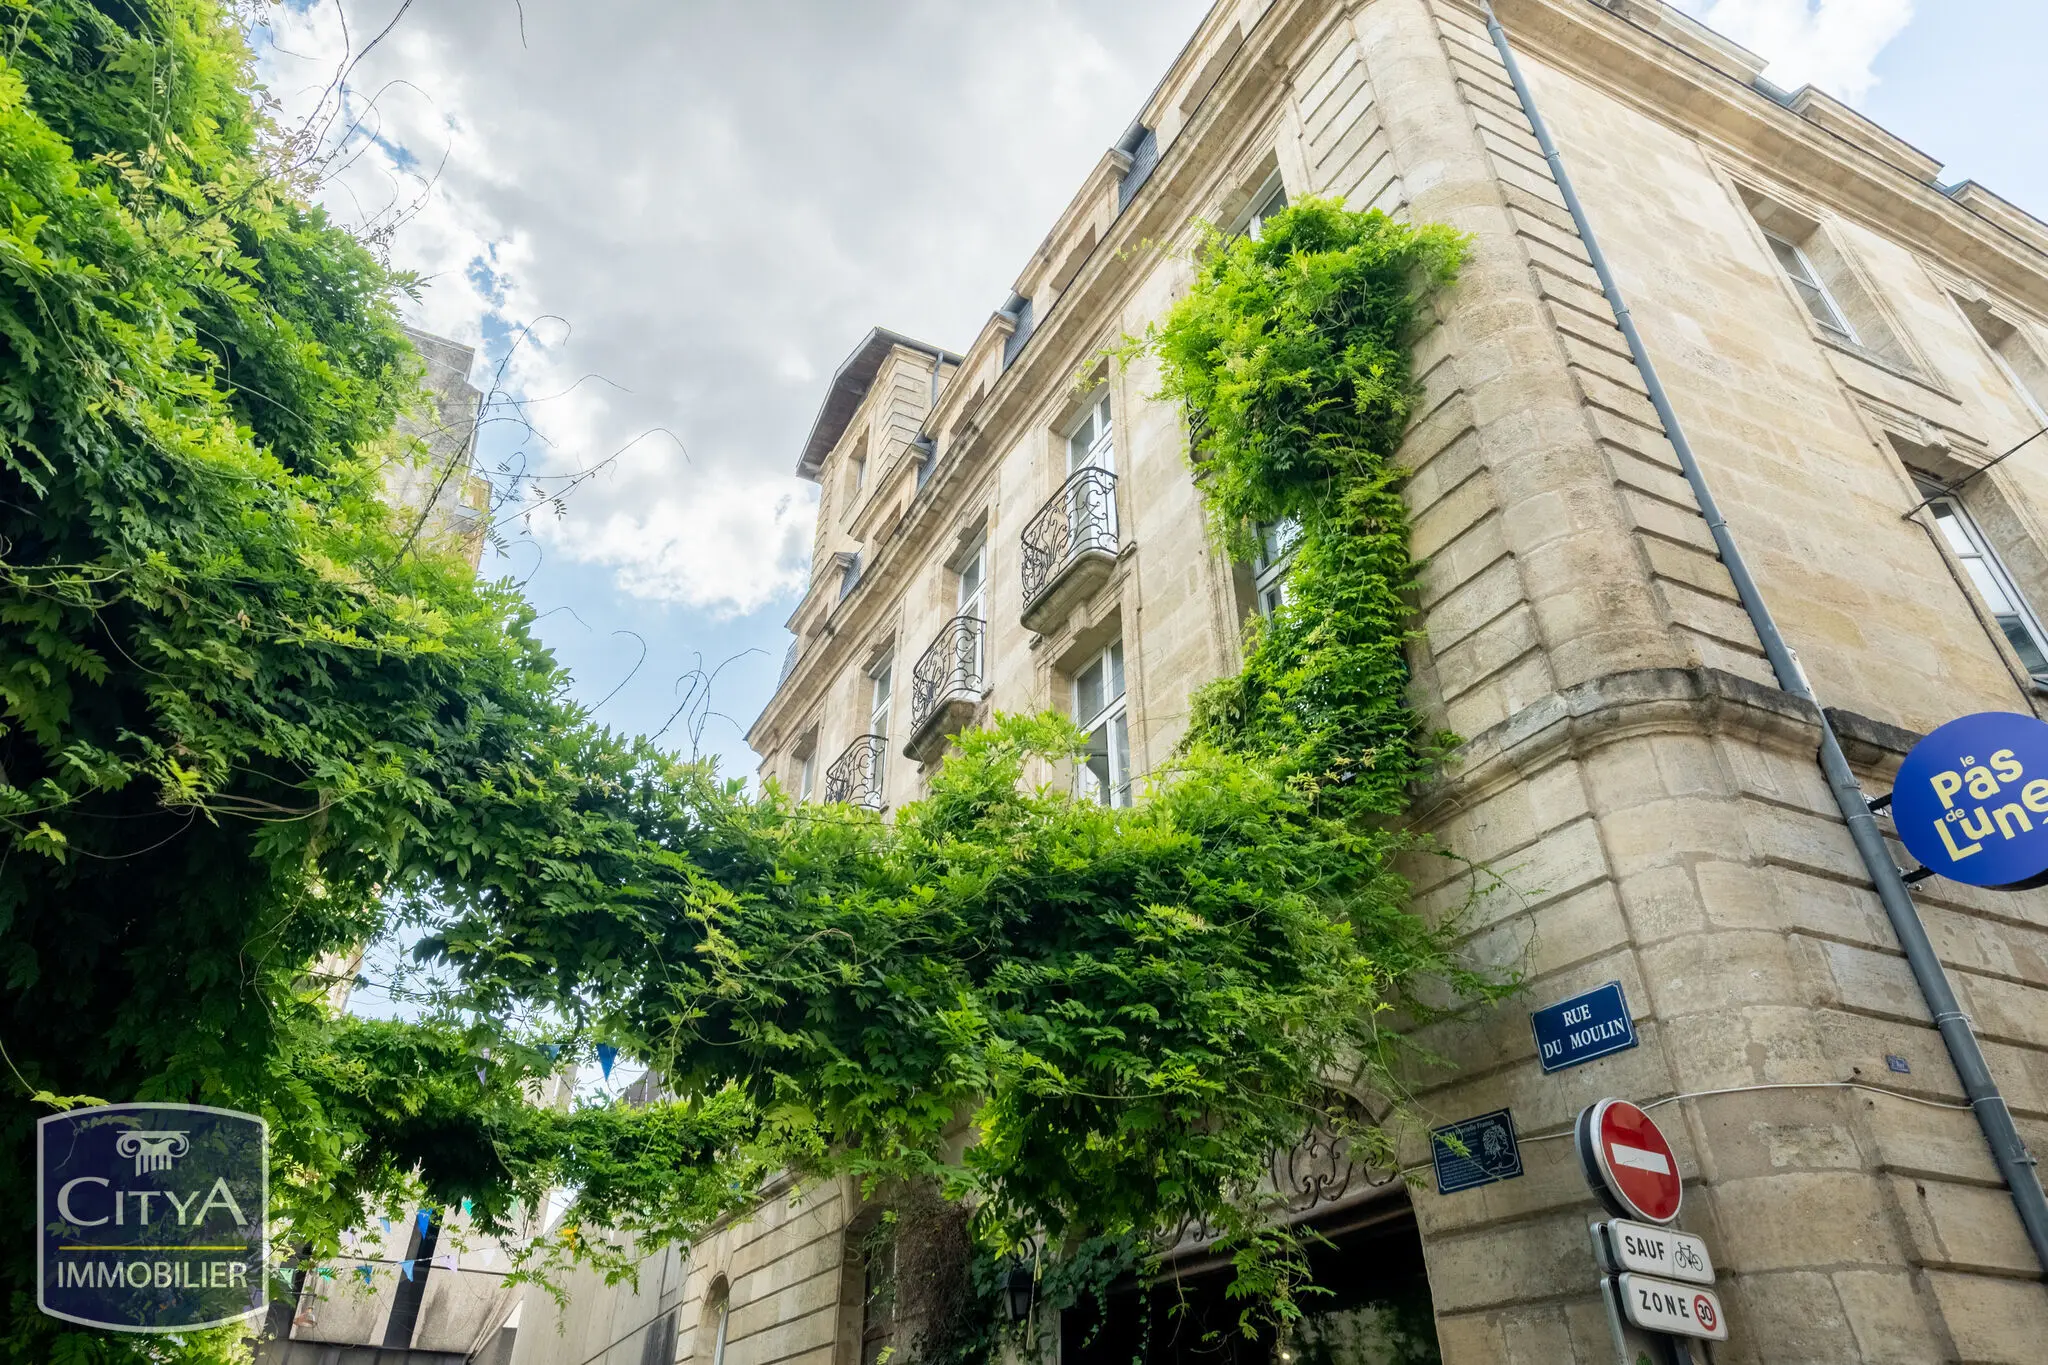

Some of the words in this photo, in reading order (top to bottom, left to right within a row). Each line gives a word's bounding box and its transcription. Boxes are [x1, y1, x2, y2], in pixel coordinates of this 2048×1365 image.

[1960, 755, 1975, 767] le
[1929, 749, 2023, 809] Pas
[1933, 778, 2048, 862] Lune
[1945, 807, 1965, 823] de
[1562, 1004, 1591, 1027] RUE
[1543, 1039, 1563, 1059] DU
[1569, 1017, 1625, 1050] MOULIN
[1624, 1235, 1665, 1261] SAUF
[1639, 1290, 1690, 1319] ZONE
[1697, 1304, 1713, 1322] 30
